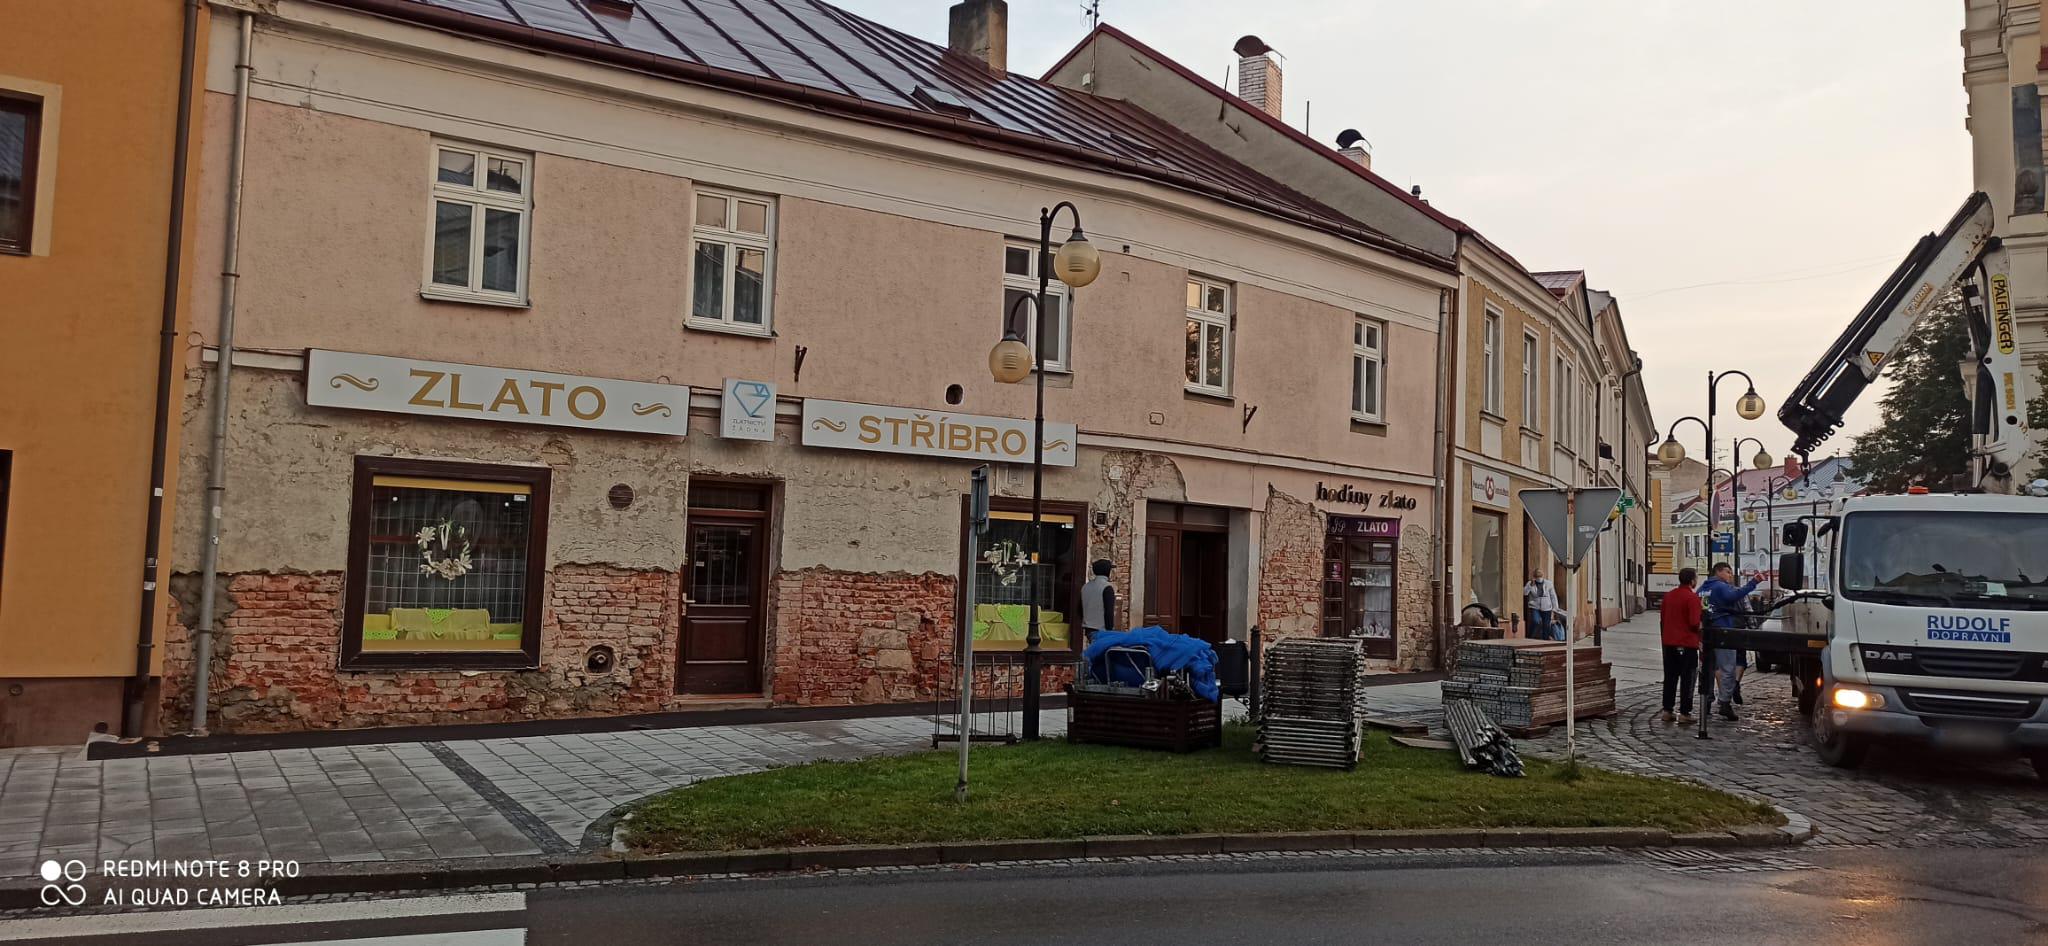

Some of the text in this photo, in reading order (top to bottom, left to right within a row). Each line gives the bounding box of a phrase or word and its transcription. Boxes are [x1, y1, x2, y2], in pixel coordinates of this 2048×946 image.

[1993, 278, 2013, 350] PALFINGER
[407, 367, 607, 421] ZLATO
[858, 413, 1027, 456] STŘÍBRO
[1315, 481, 1417, 512] hodiny zlato
[1357, 521, 1389, 533] ZLATO
[1927, 615, 2010, 632] RUDOLF
[1931, 630, 2005, 642] DOPRAVNÍ
[1865, 650, 1913, 661] DAF
